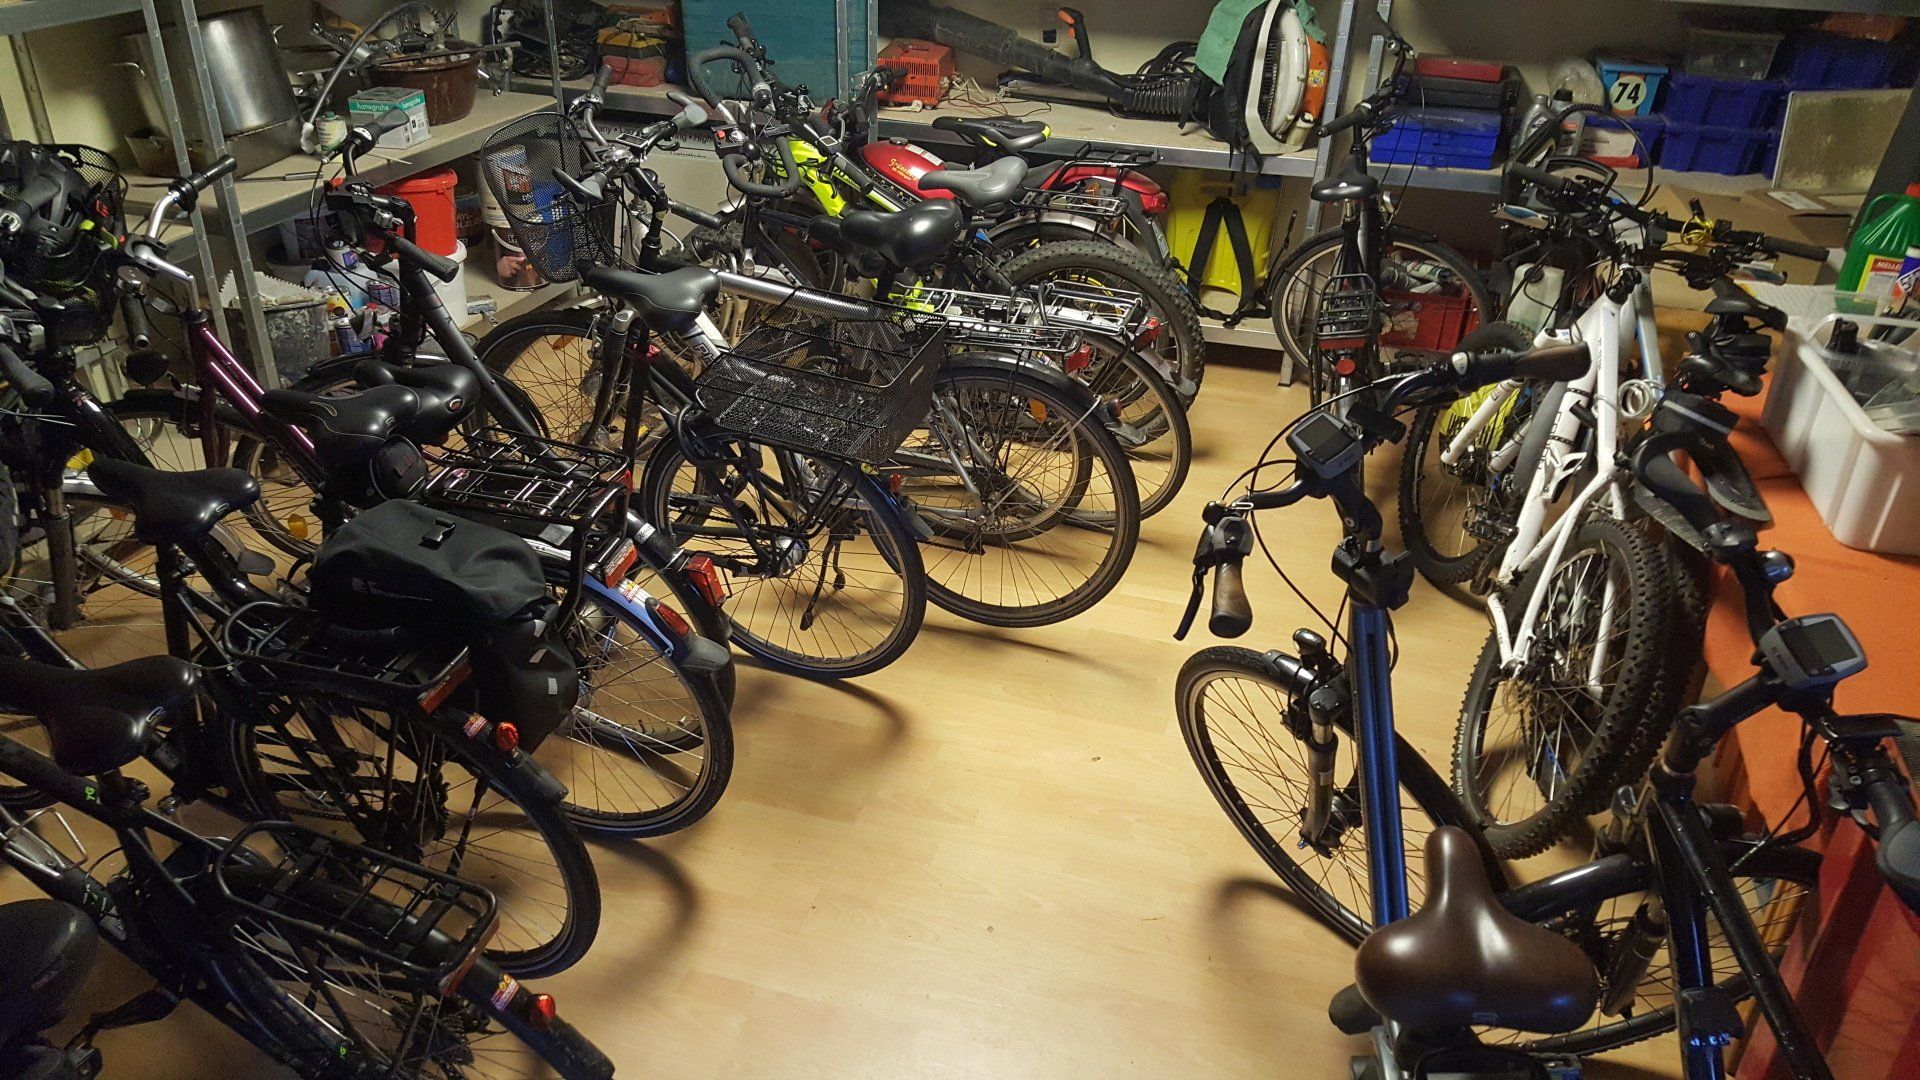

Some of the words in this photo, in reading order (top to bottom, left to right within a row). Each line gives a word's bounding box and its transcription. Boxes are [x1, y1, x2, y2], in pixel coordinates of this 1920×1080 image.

[1613, 82, 1642, 104] 74
[1456, 712, 1468, 764] SMART
[1456, 768, 1464, 795] SAM
